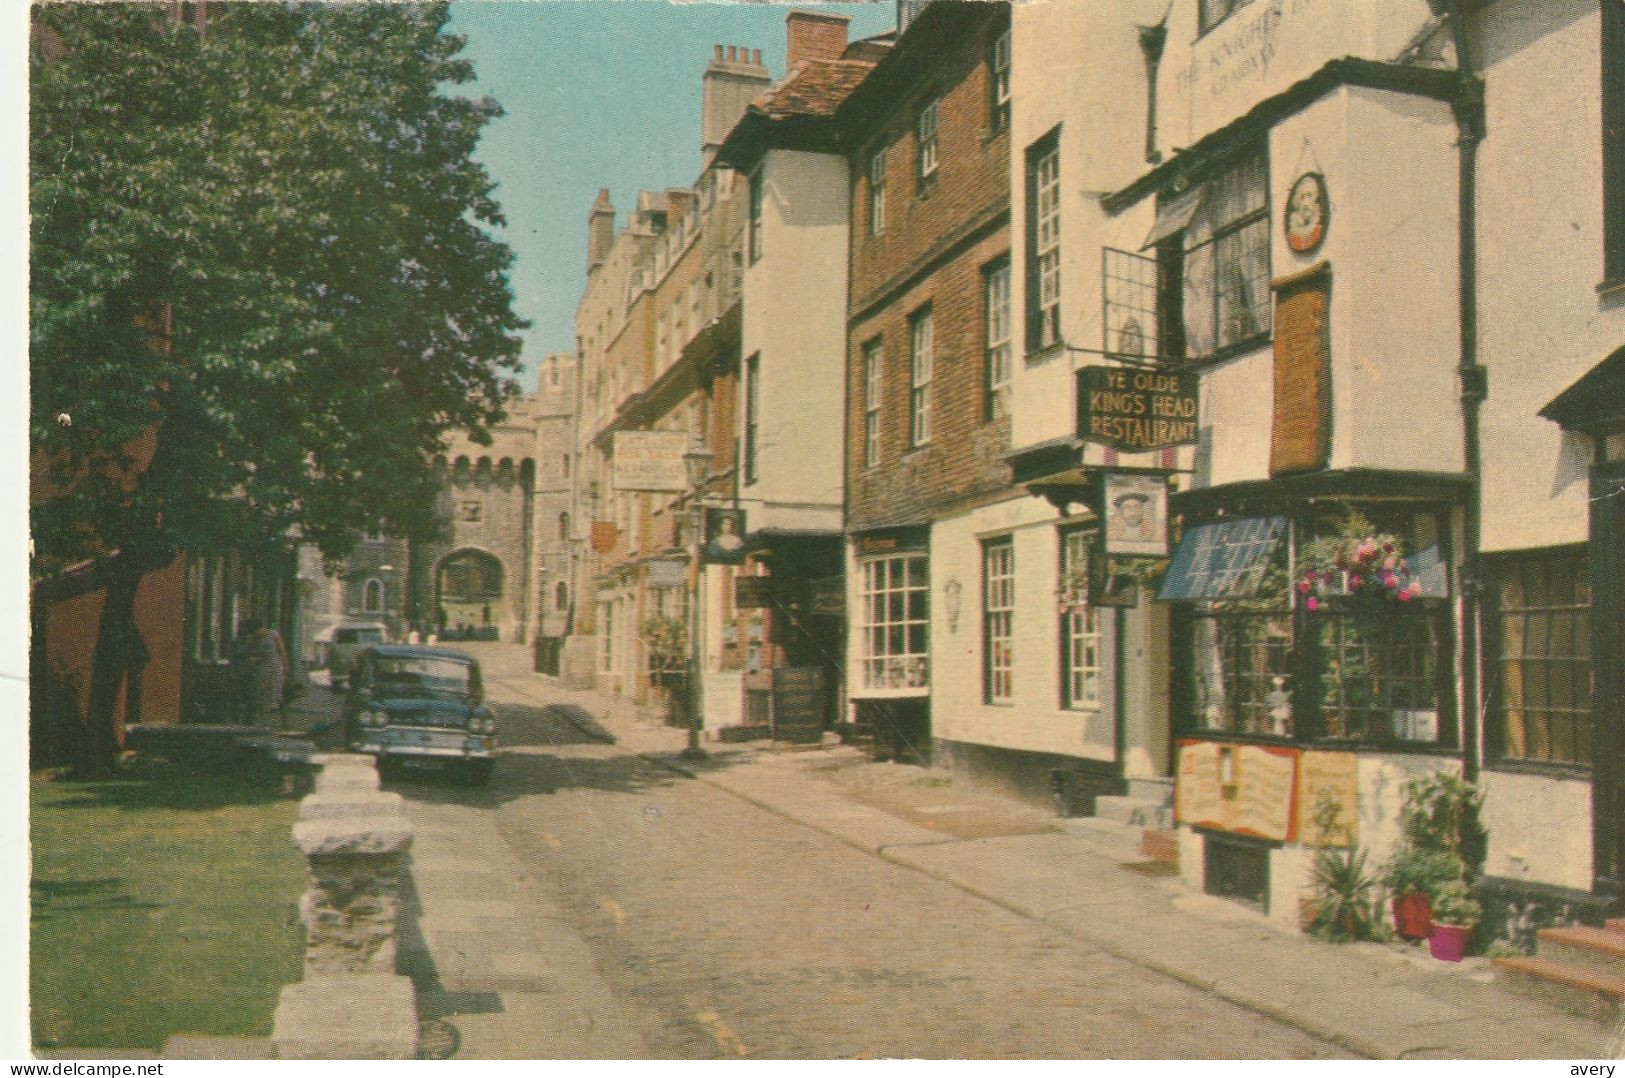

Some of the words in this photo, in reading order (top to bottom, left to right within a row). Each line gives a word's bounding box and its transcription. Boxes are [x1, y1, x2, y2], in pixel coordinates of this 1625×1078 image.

[1106, 370, 1127, 389] YE
[1134, 373, 1180, 393] OLDE
[1089, 391, 1146, 415] KING'S
[1152, 395, 1197, 418] HEAD
[1091, 415, 1197, 448] RESTAURANT
